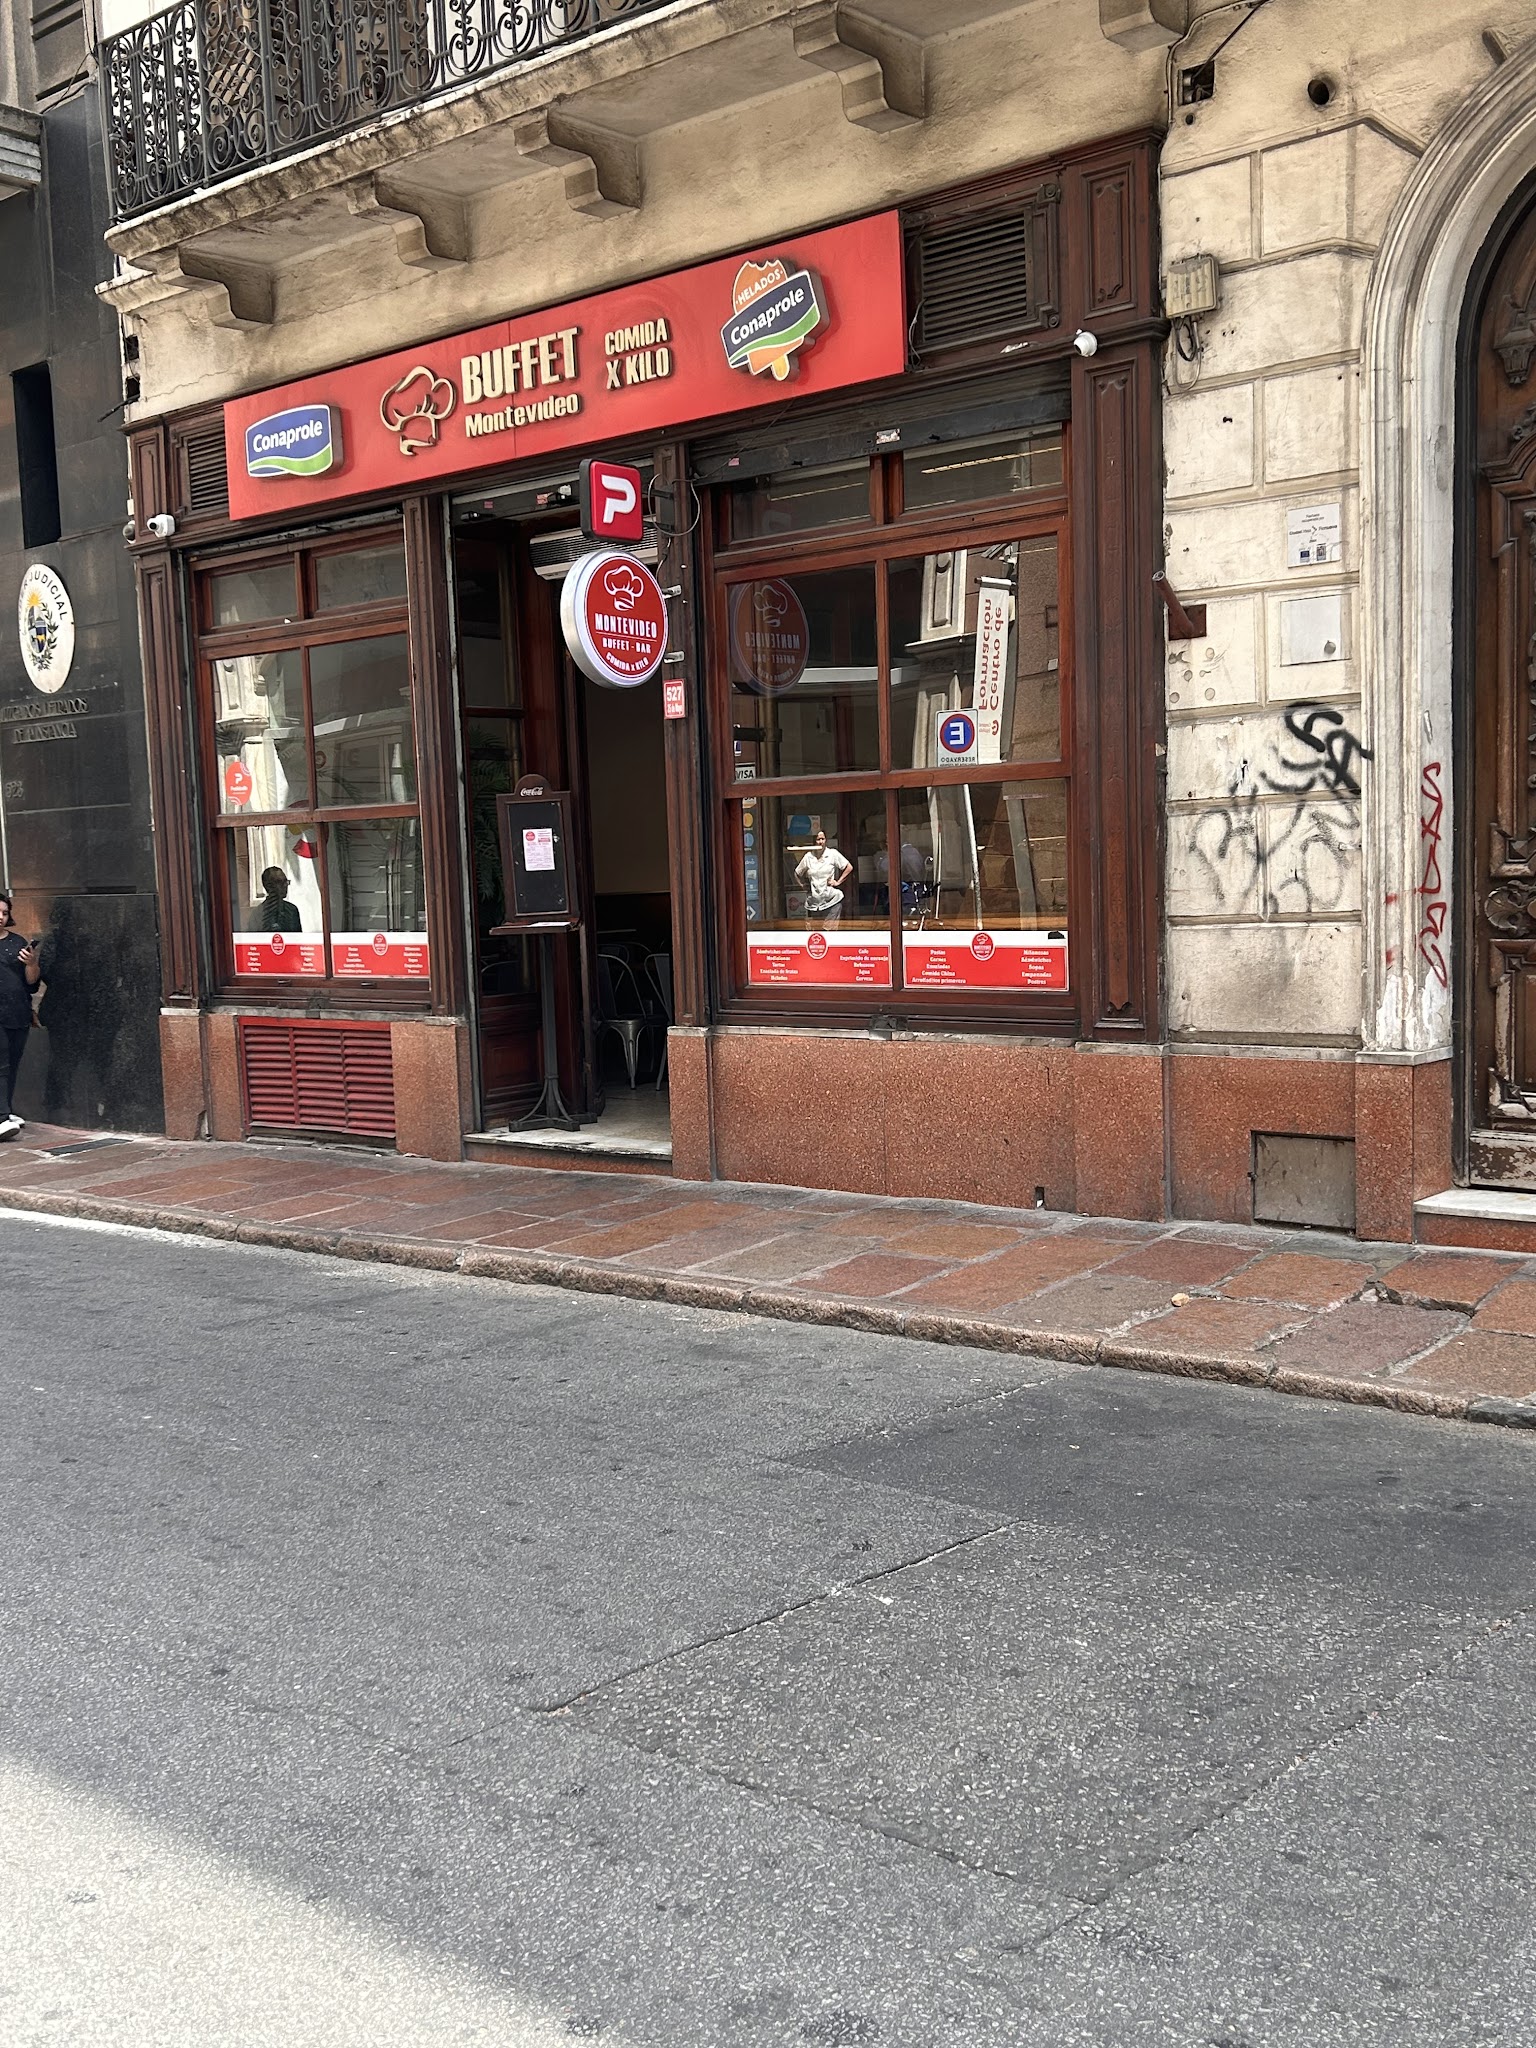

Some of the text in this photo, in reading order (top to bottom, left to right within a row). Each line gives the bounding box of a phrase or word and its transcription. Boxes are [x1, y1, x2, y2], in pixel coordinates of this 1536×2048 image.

[738, 268, 780, 305] HELADOS
[731, 288, 805, 344] Conaprole
[604, 318, 669, 356] COMIDA
[461, 327, 579, 405] BUFFET
[606, 347, 671, 390] X KILO
[465, 393, 580, 437] Montevideo
[252, 419, 323, 453] Conaprole
[29, 570, 68, 621] JUDICIAL
[595, 612, 657, 639] MONTEVIDEO
[602, 637, 630, 651] BUFFET
[636, 642, 651, 654] BAR
[606, 651, 631, 672] COMIDA
[635, 656, 649, 671] KILO
[666, 686, 682, 702] 527
[736, 770, 754, 779] VISA
